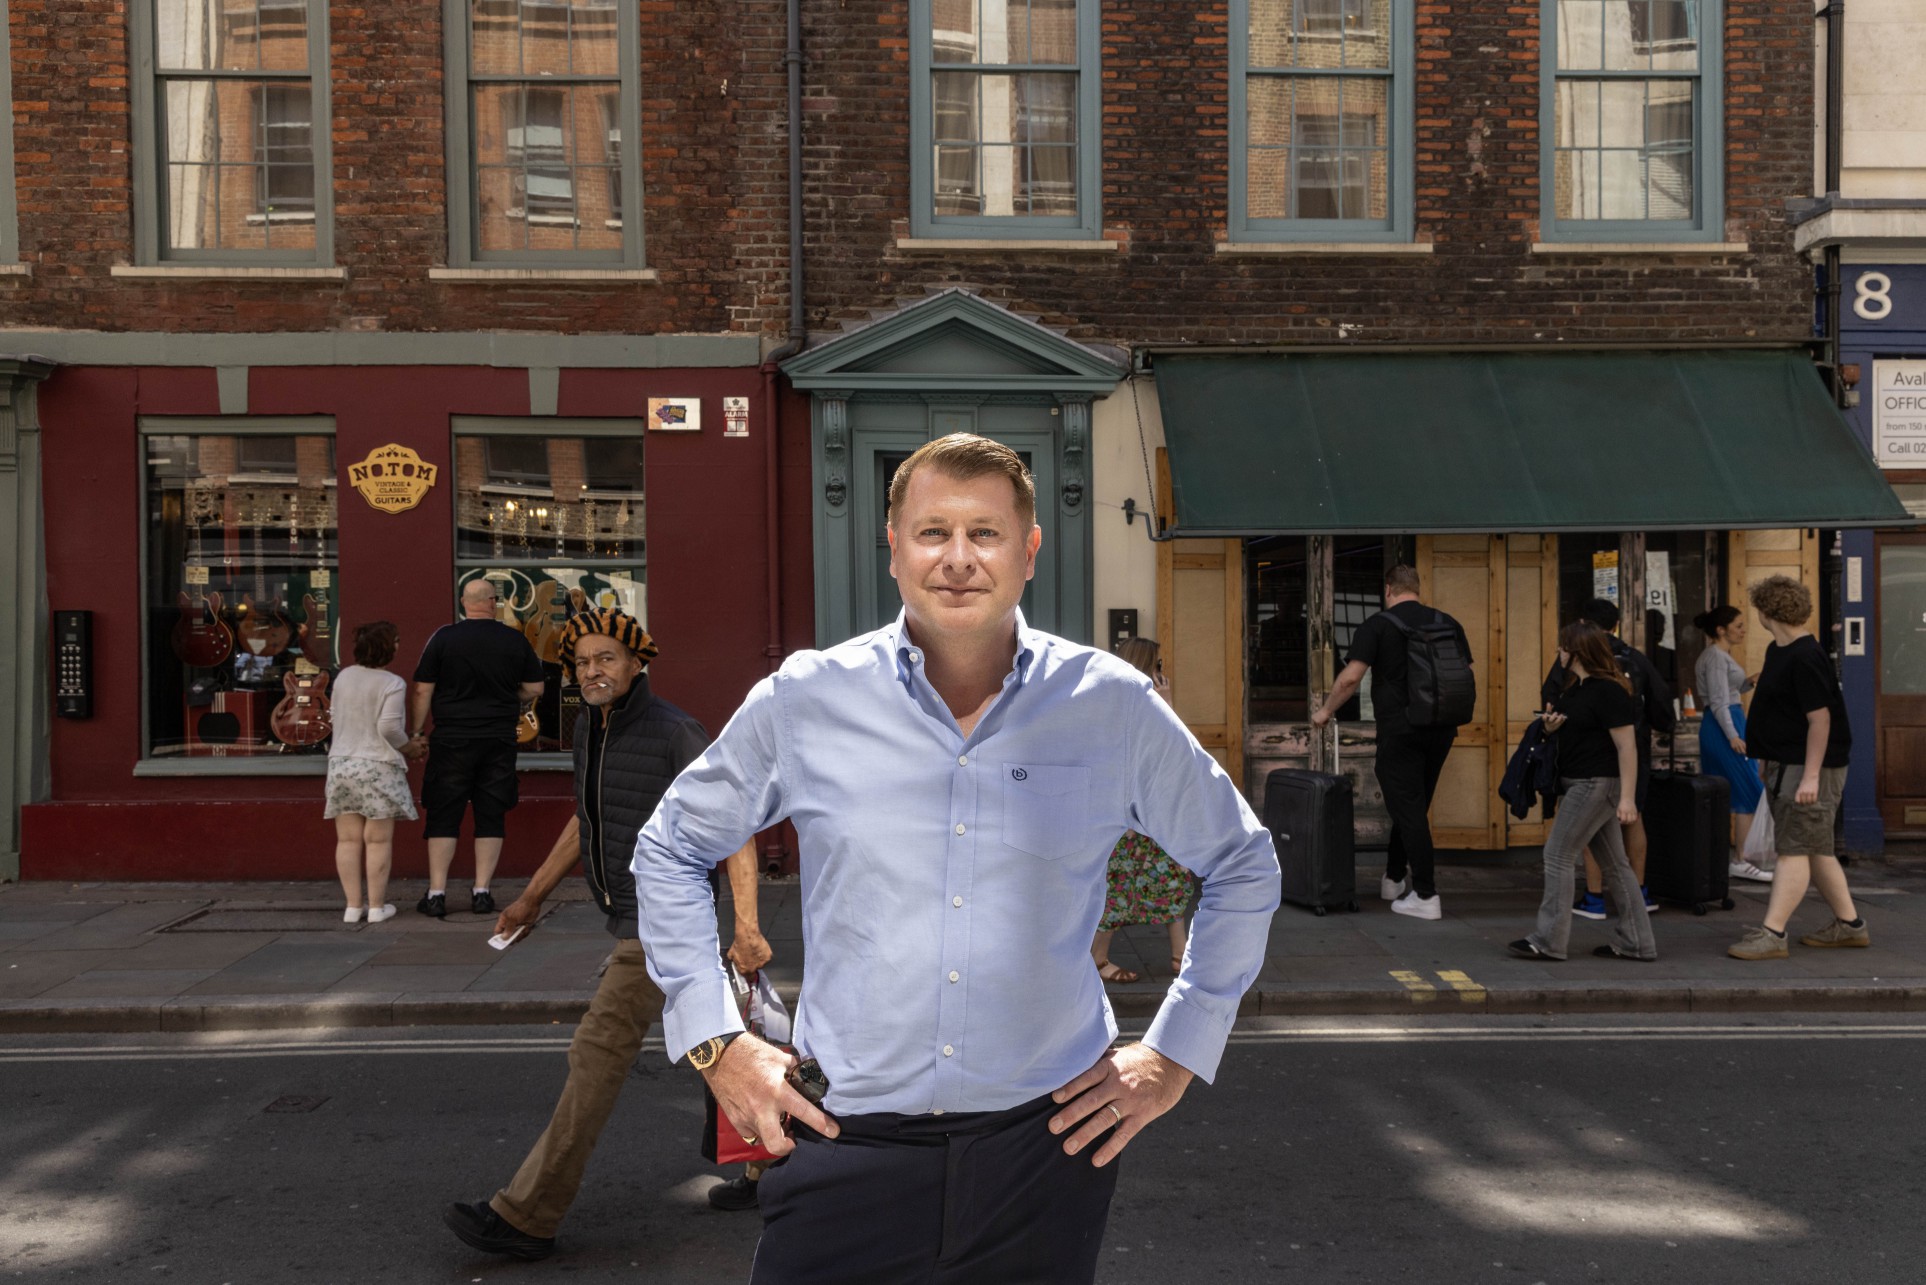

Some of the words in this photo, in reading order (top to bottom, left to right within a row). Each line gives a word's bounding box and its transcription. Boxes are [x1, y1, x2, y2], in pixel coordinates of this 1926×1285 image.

[1853, 271, 1892, 320] 8
[1886, 422, 1906, 431] from
[1908, 422, 1923, 431] 150
[1887, 442, 1911, 454] Call
[353, 462, 433, 481] NO.TOM
[563, 696, 581, 704] VOX
